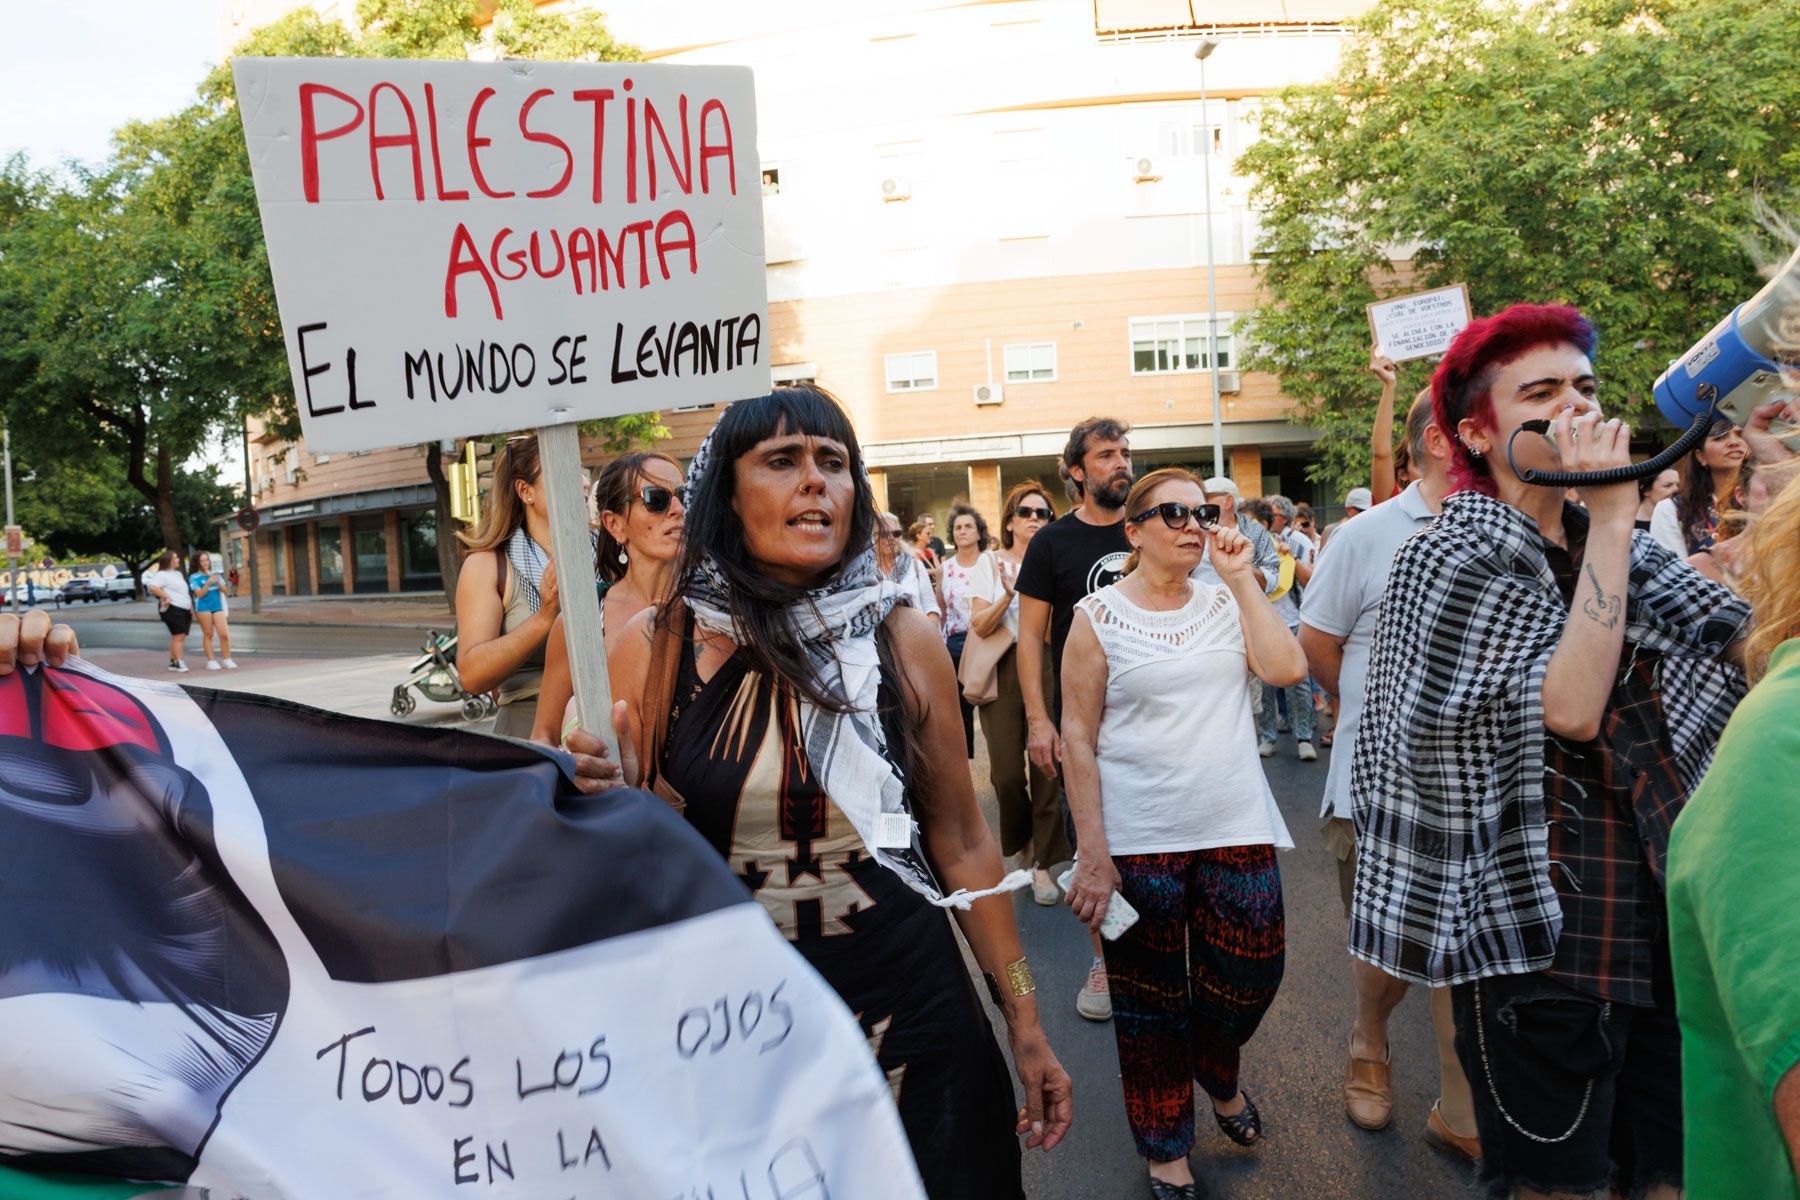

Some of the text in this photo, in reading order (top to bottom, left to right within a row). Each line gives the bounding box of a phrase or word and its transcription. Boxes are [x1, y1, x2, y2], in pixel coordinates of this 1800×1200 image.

[445, 210, 697, 320] AGUANTA
[296, 314, 760, 418] EL MUNDO SE LEVANTA
[316, 980, 793, 1109] TODOS LOS OJOS
[453, 1135, 515, 1185] EN
[556, 1126, 612, 1172] LA
